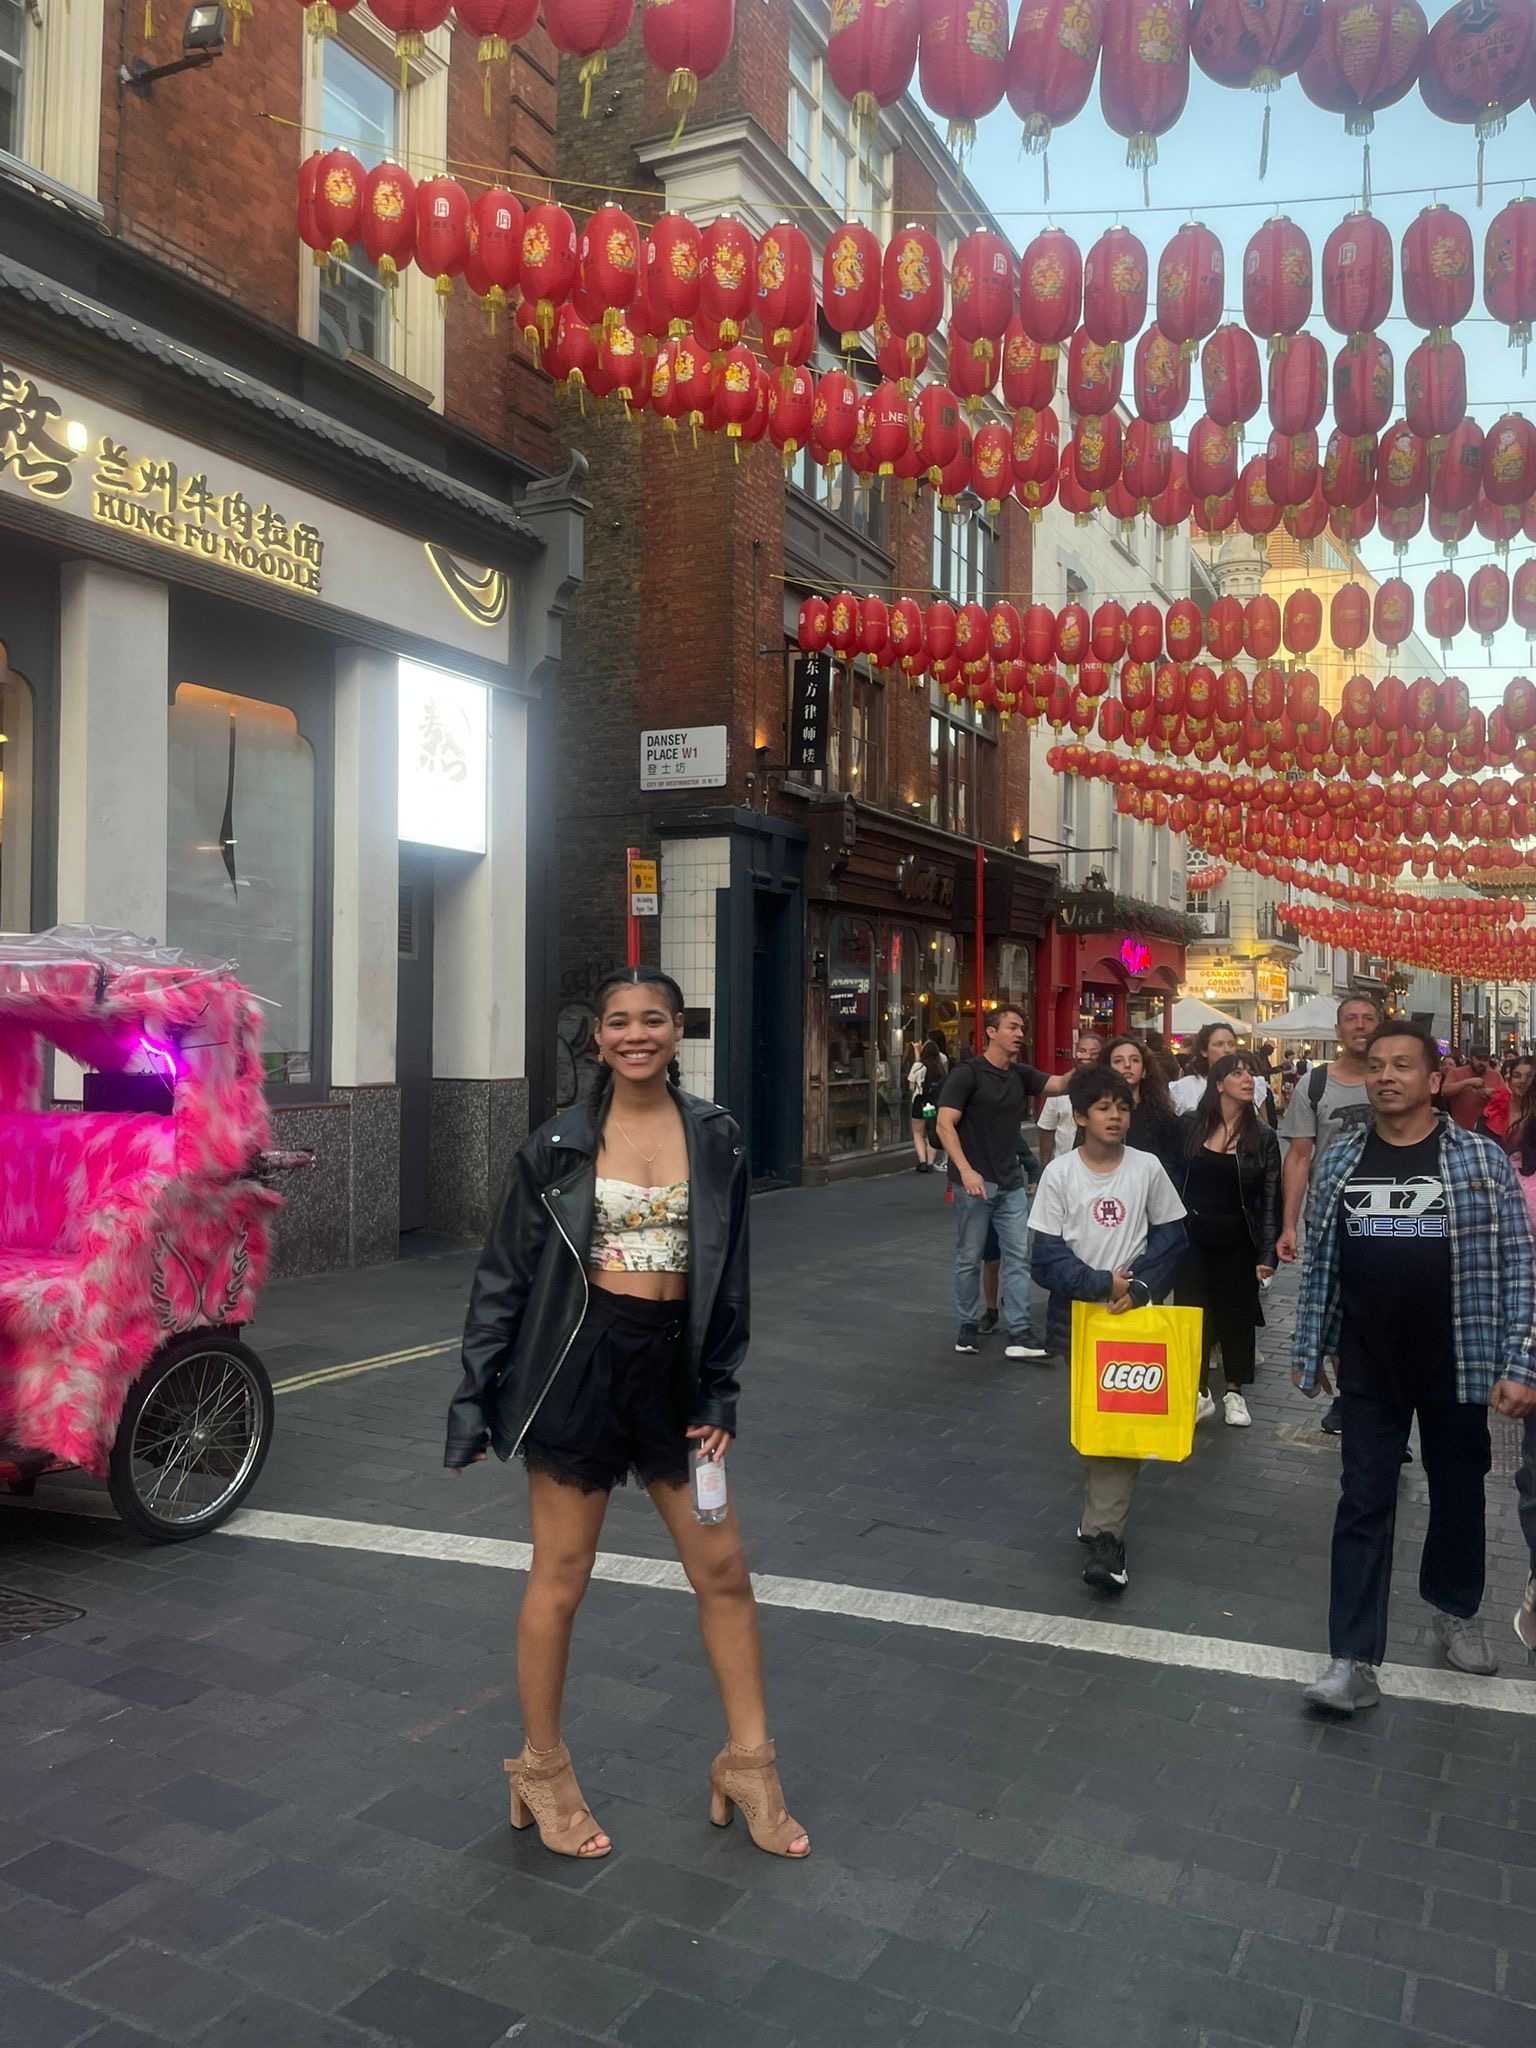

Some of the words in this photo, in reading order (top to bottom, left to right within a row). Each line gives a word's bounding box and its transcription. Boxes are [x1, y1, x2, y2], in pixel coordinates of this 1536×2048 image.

[94, 437, 324, 567] 兰州牛肉拉面
[96, 492, 176, 541] KUNG
[184, 523, 217, 553] FU
[224, 538, 322, 593] NOODLE
[647, 733, 688, 747] DANSEY
[803, 660, 820, 764] 东方律师楼
[647, 748, 678, 761] PLACE
[682, 747, 697, 759] W1
[1102, 1362, 1163, 1392] LEGO
